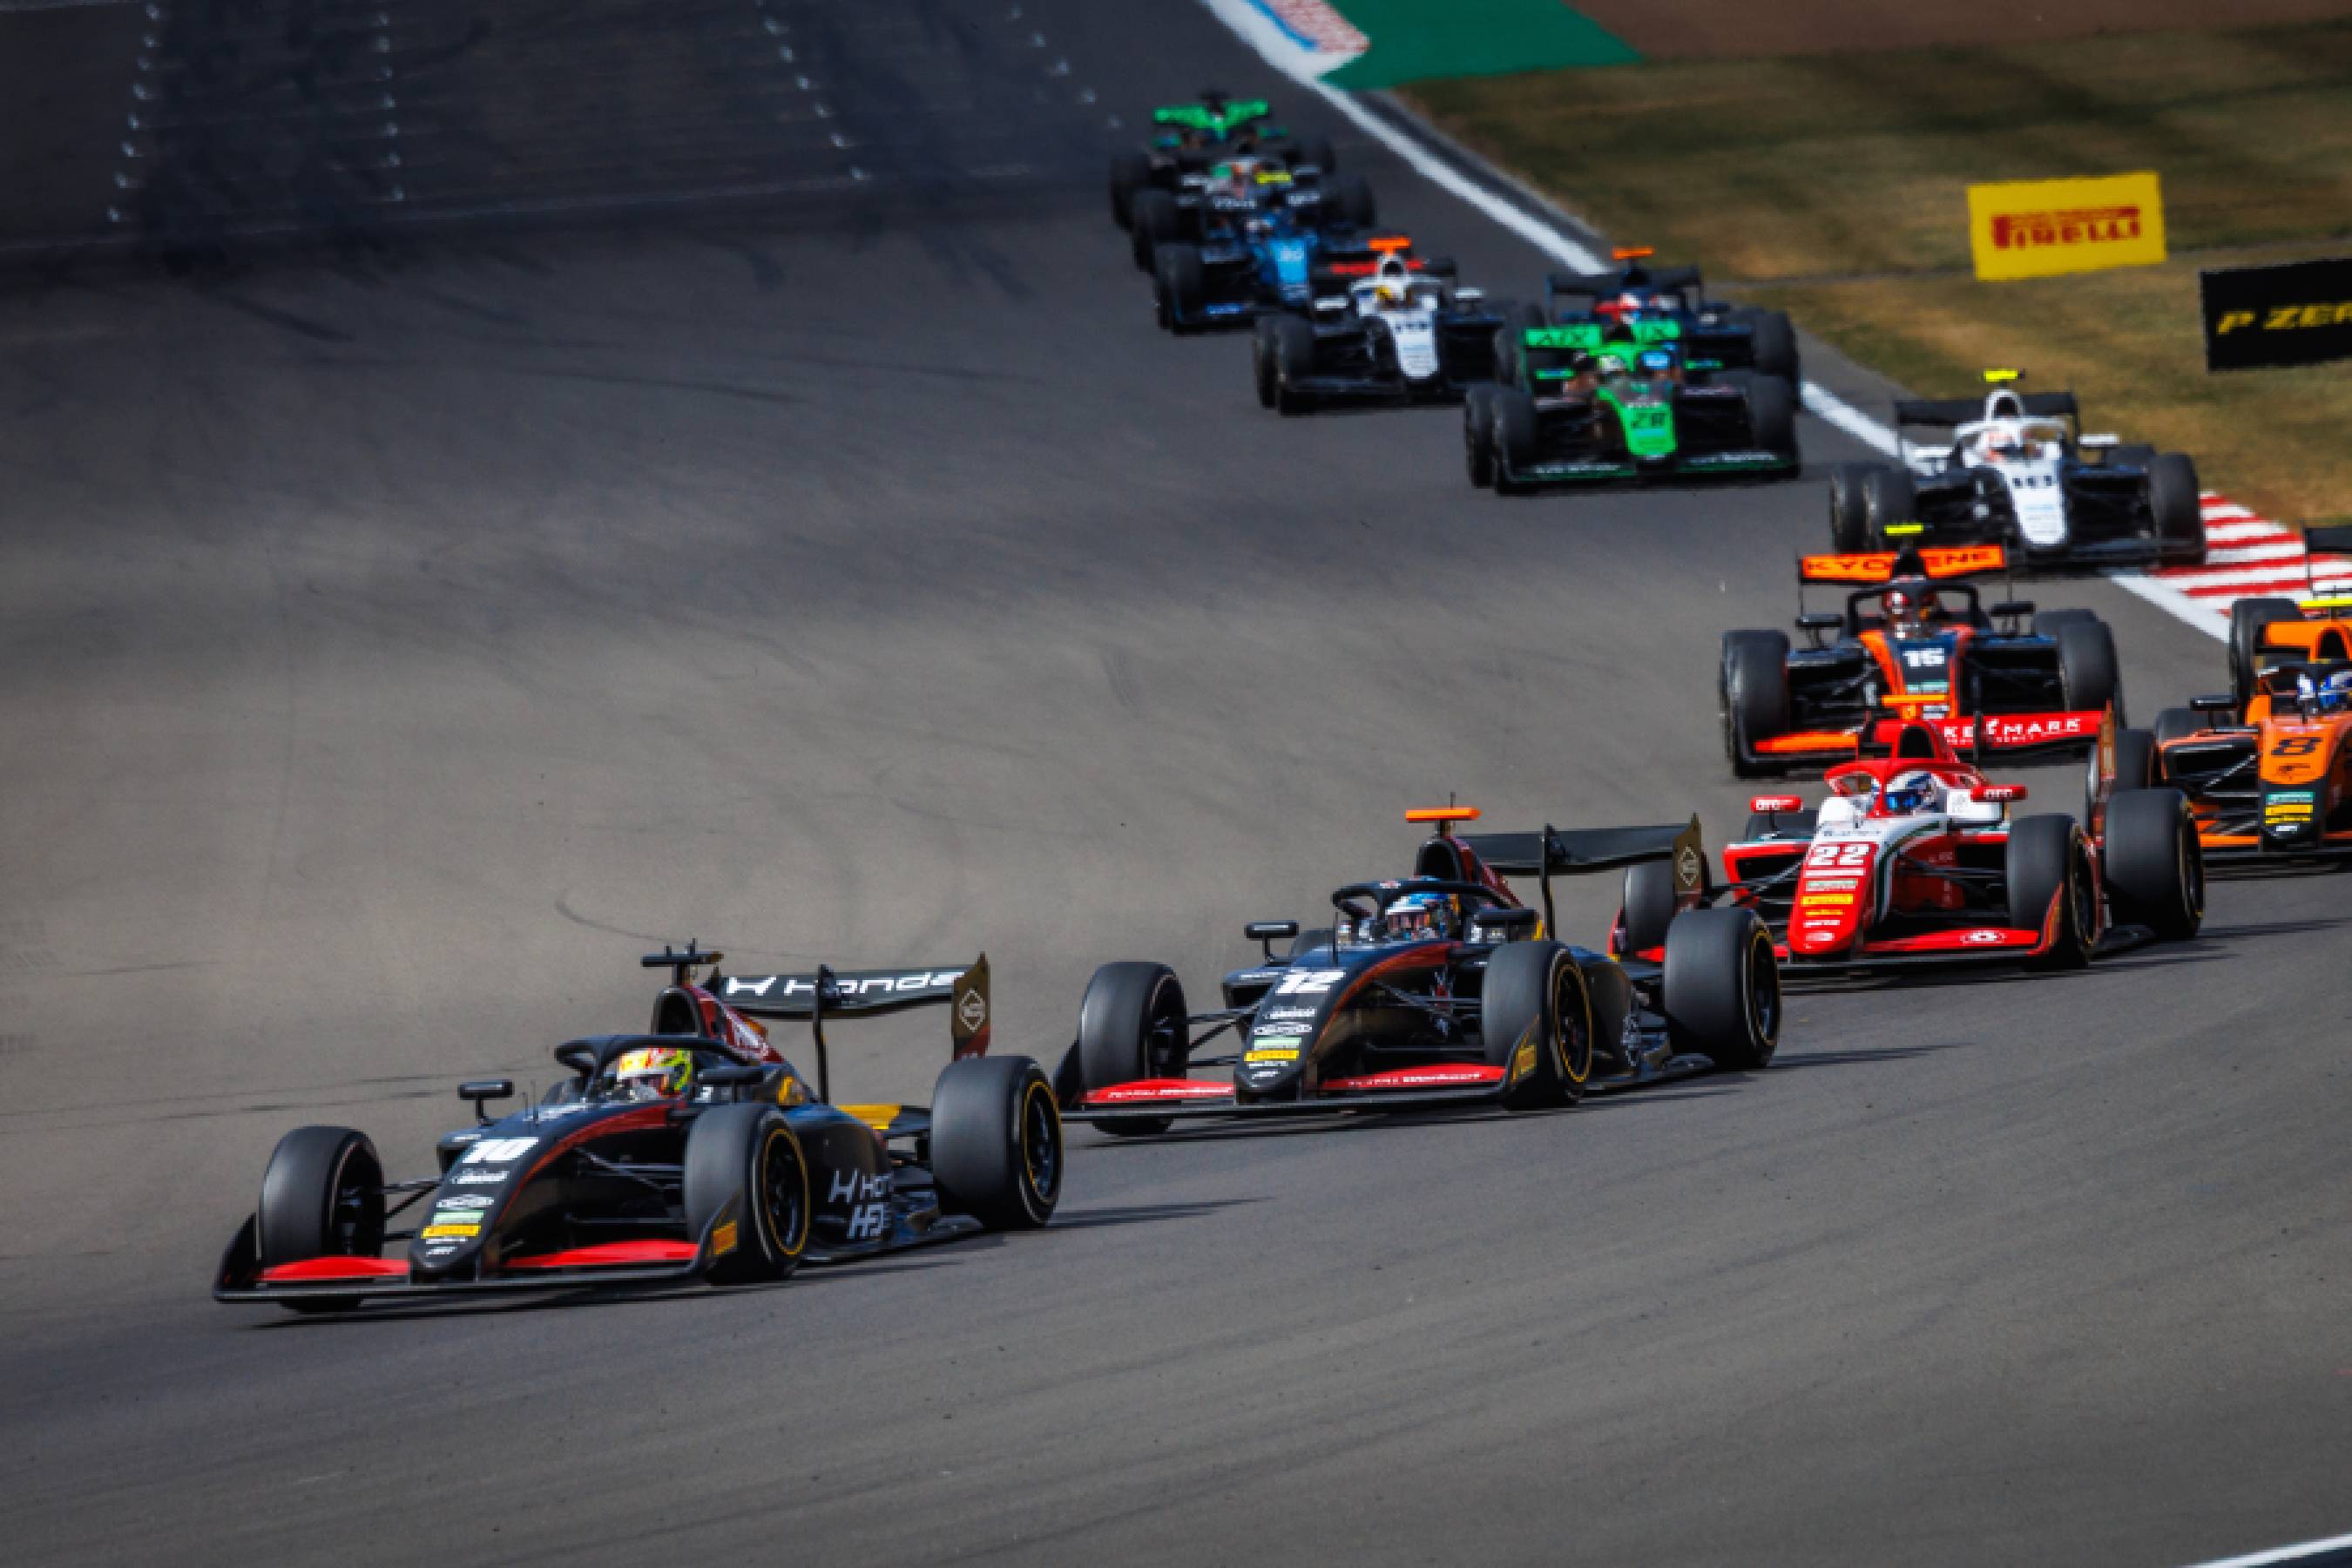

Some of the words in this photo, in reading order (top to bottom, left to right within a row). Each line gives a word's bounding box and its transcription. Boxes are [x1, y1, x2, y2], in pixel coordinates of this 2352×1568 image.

[1990, 205, 2141, 250] PIRELLI
[2216, 310, 2255, 335] P
[1903, 647, 1946, 668] 15
[2270, 736, 2323, 756] 8
[1808, 841, 1871, 867] 22
